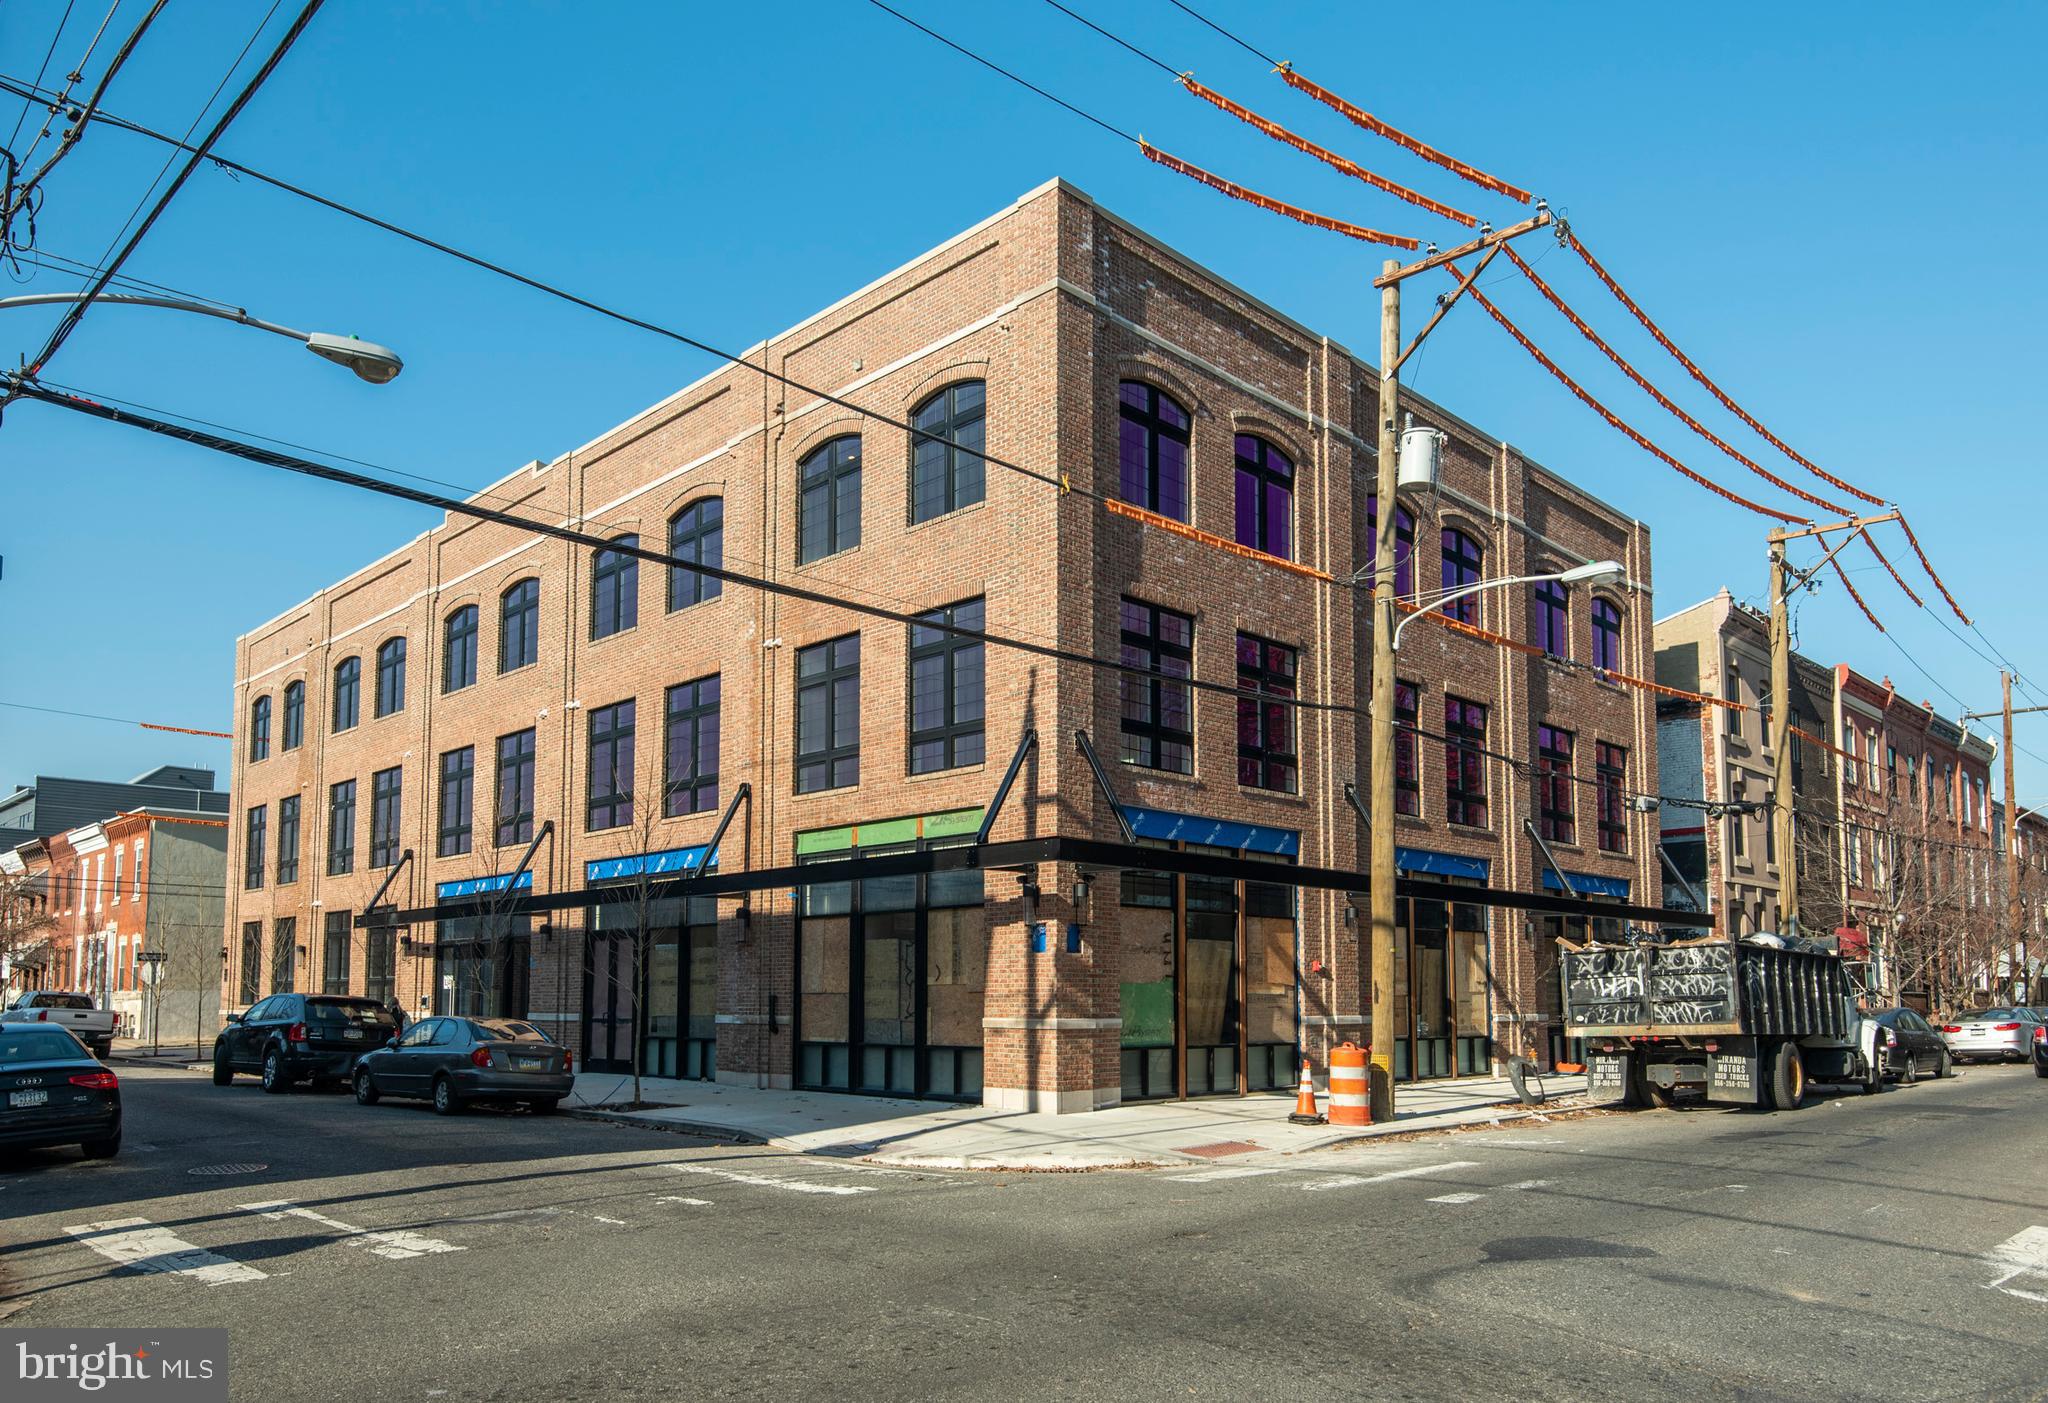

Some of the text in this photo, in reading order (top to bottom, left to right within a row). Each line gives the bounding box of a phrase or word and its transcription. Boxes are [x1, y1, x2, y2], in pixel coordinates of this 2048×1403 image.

[1596, 1064, 1619, 1073] MOTORS
[1718, 1064, 1746, 1074] MOTORS
[1714, 1072, 1750, 1081] USED TRUCKS
